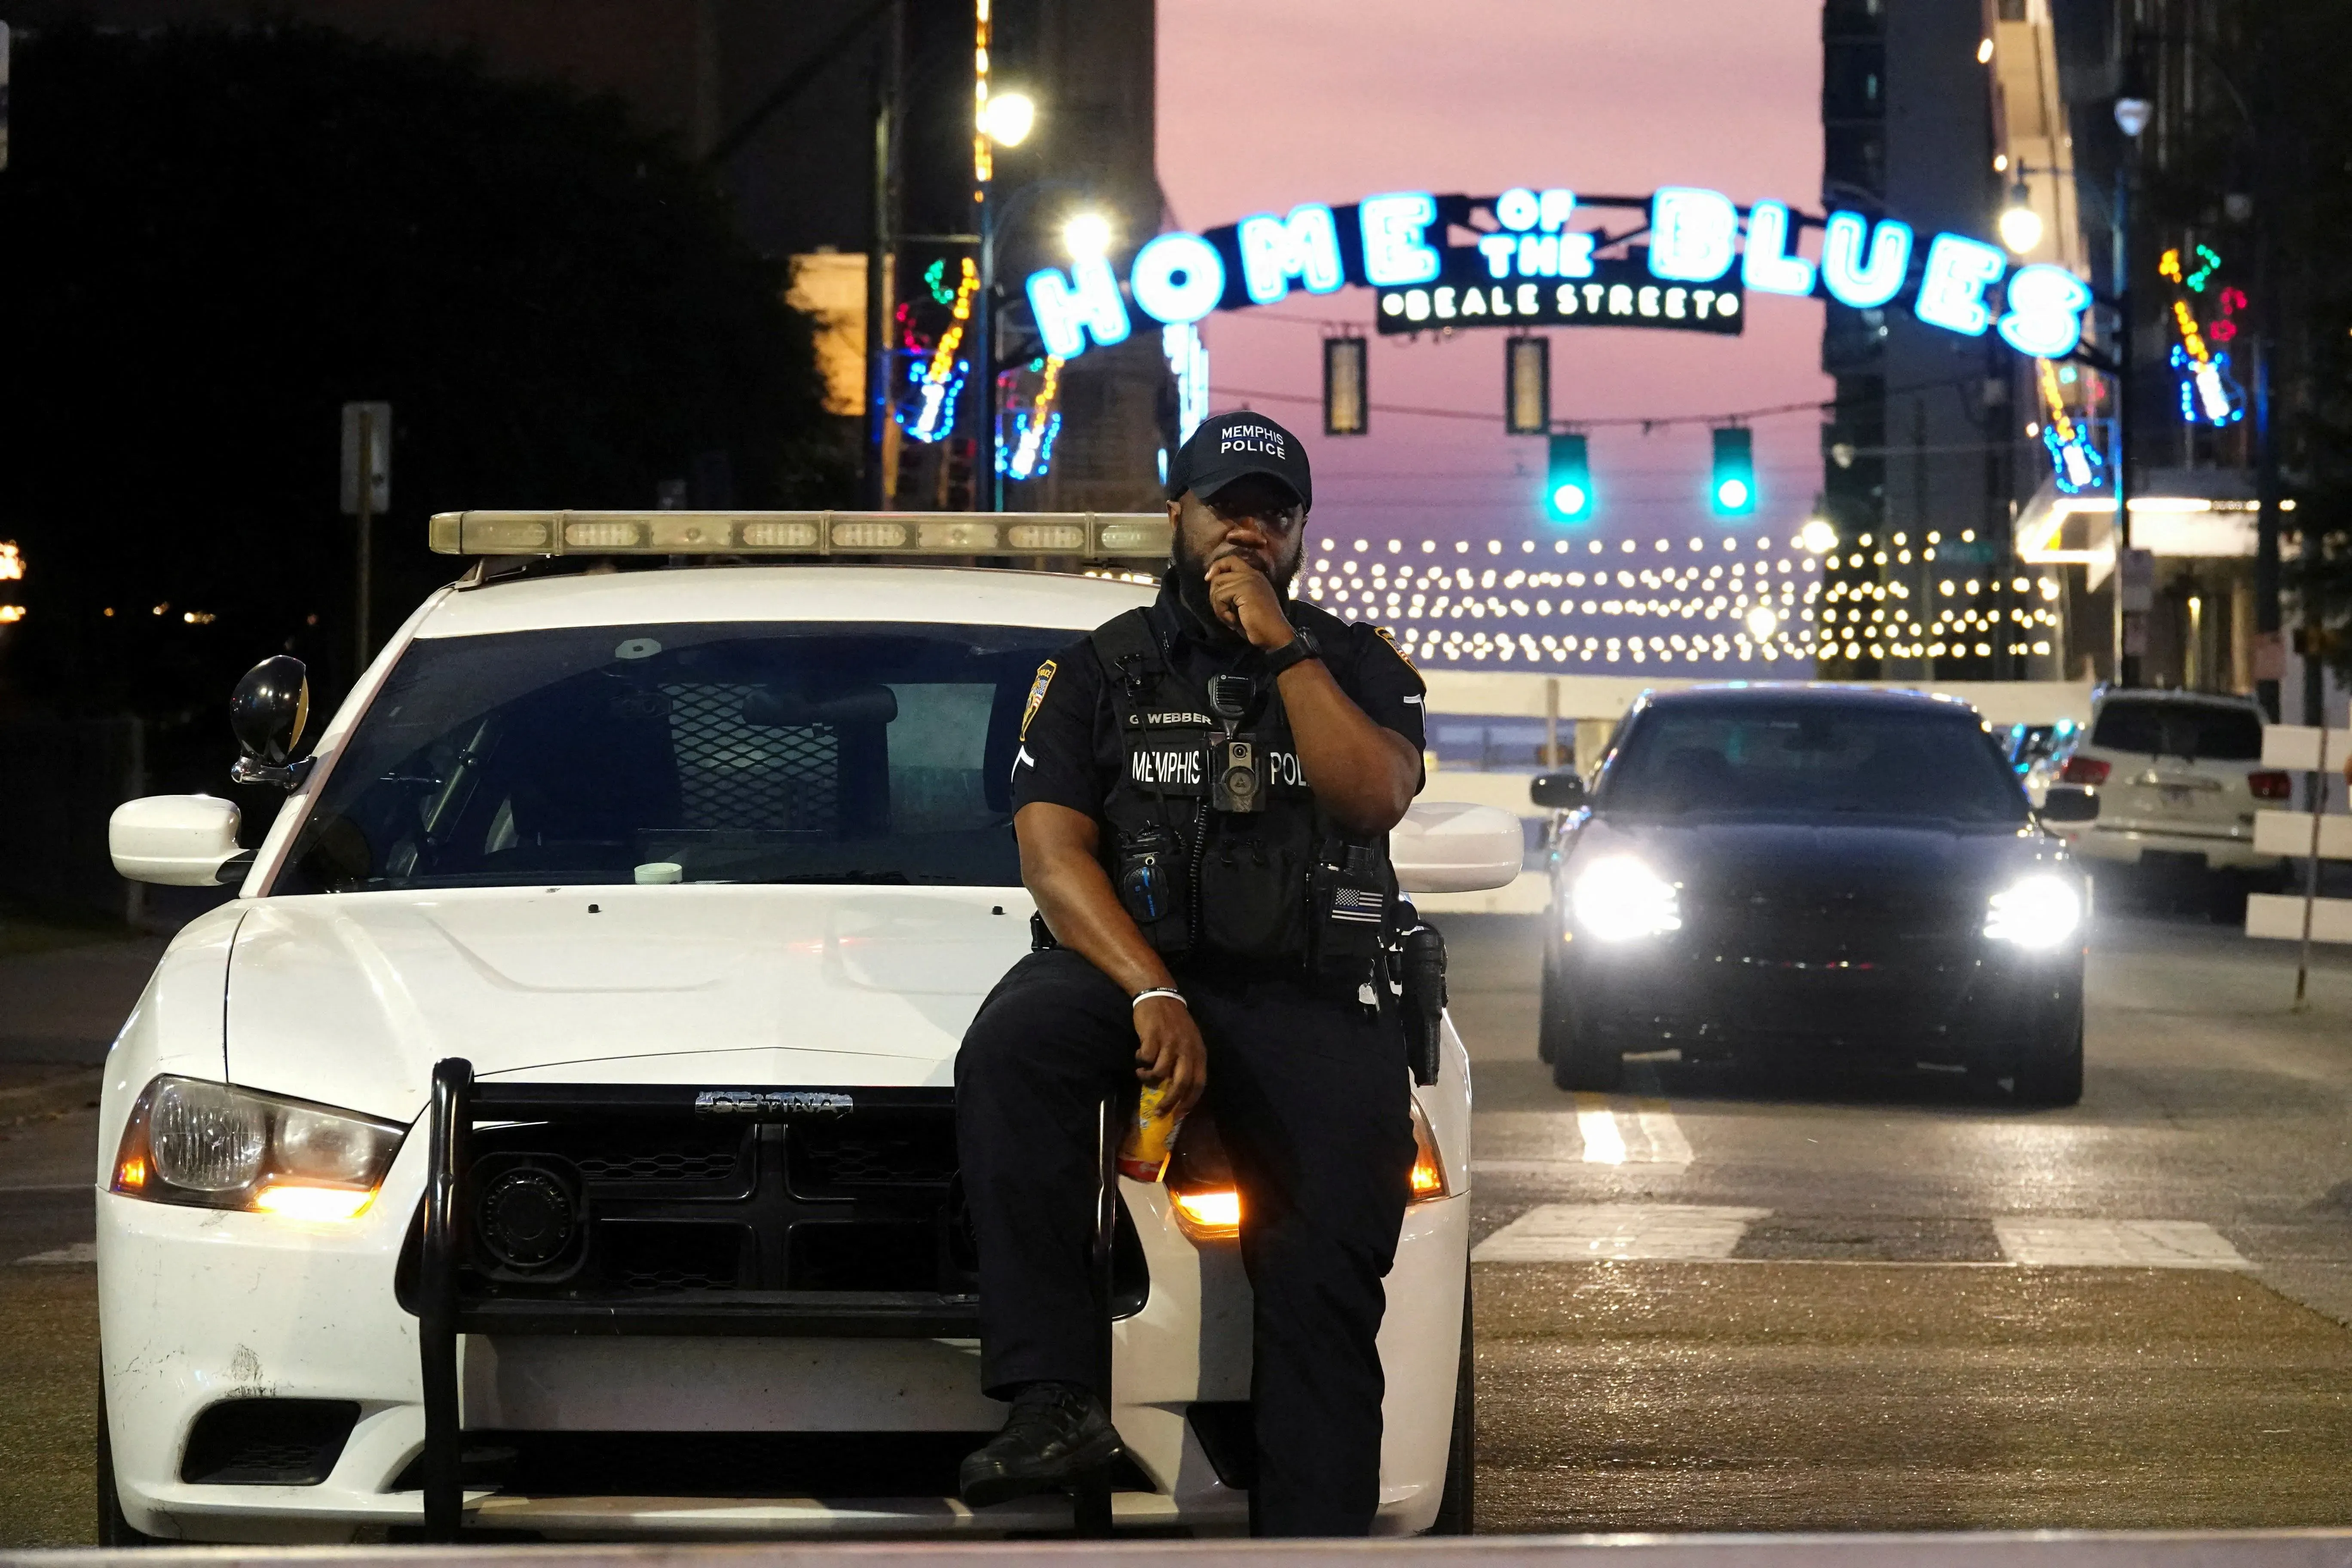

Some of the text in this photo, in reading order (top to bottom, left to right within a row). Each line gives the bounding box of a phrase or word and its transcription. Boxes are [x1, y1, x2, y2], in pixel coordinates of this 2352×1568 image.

[1497, 188, 1576, 232] OF
[1478, 233, 1596, 279] THE
[1648, 186, 2092, 358] BLUES
[1026, 190, 1441, 360] HOME
[1404, 284, 1716, 320] BEALE STREET
[1221, 440, 1285, 460] POLICE
[1222, 425, 1284, 445] MEMPHIS
[1147, 712, 1213, 725] WEBBER
[1132, 750, 1200, 784] MEMPHIS
